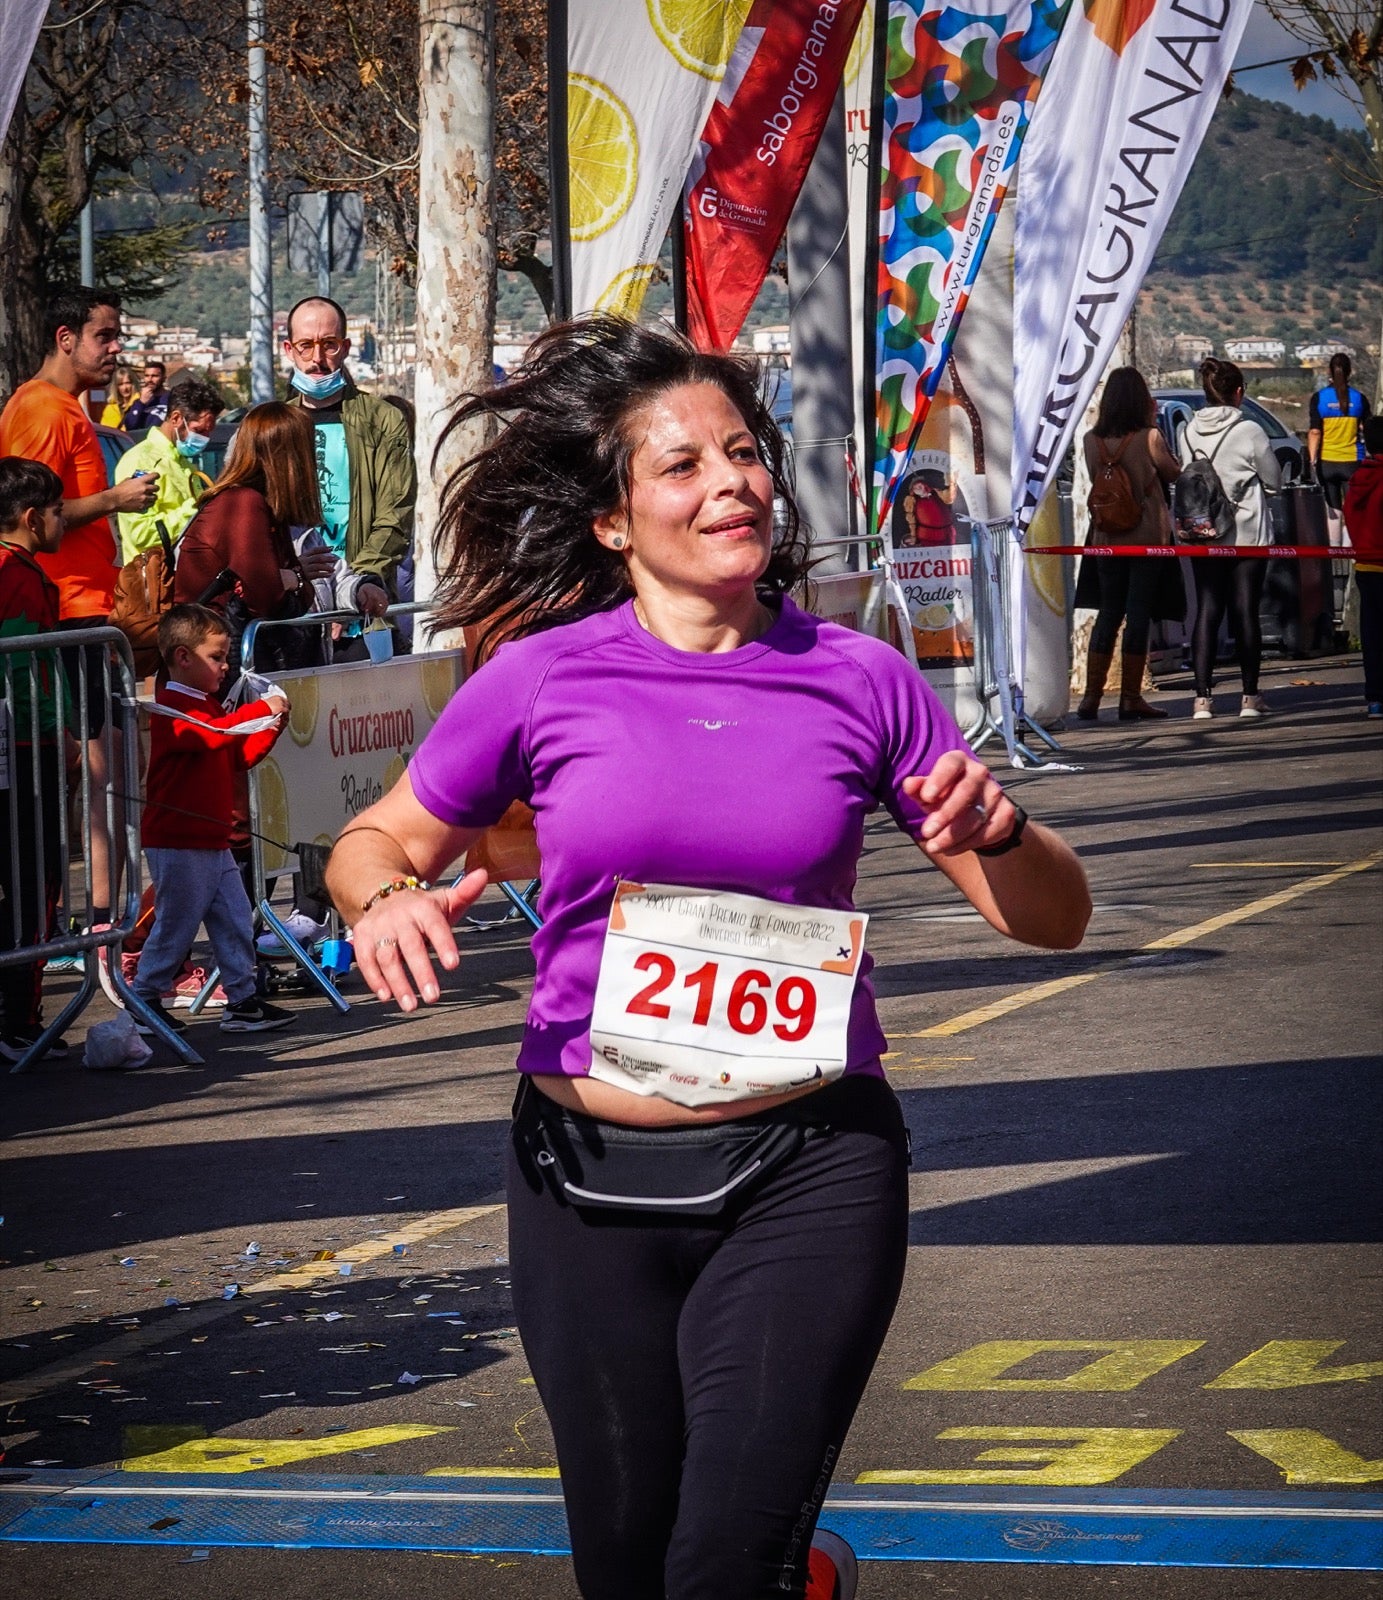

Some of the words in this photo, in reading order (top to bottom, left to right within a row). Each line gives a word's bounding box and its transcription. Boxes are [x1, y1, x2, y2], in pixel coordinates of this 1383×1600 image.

[755, 0, 841, 166] saborgrana
[718, 208, 729, 218] de
[728, 210, 767, 226] Granada
[719, 198, 768, 216] Diputación
[936, 113, 1015, 329] www.turgranada.es
[893, 558, 974, 580] uzcam
[904, 584, 963, 606] Radler
[329, 703, 414, 758] Cruzcampo
[341, 771, 383, 816] Radler
[802, 922, 835, 942] 2022
[625, 952, 817, 1042] 2169
